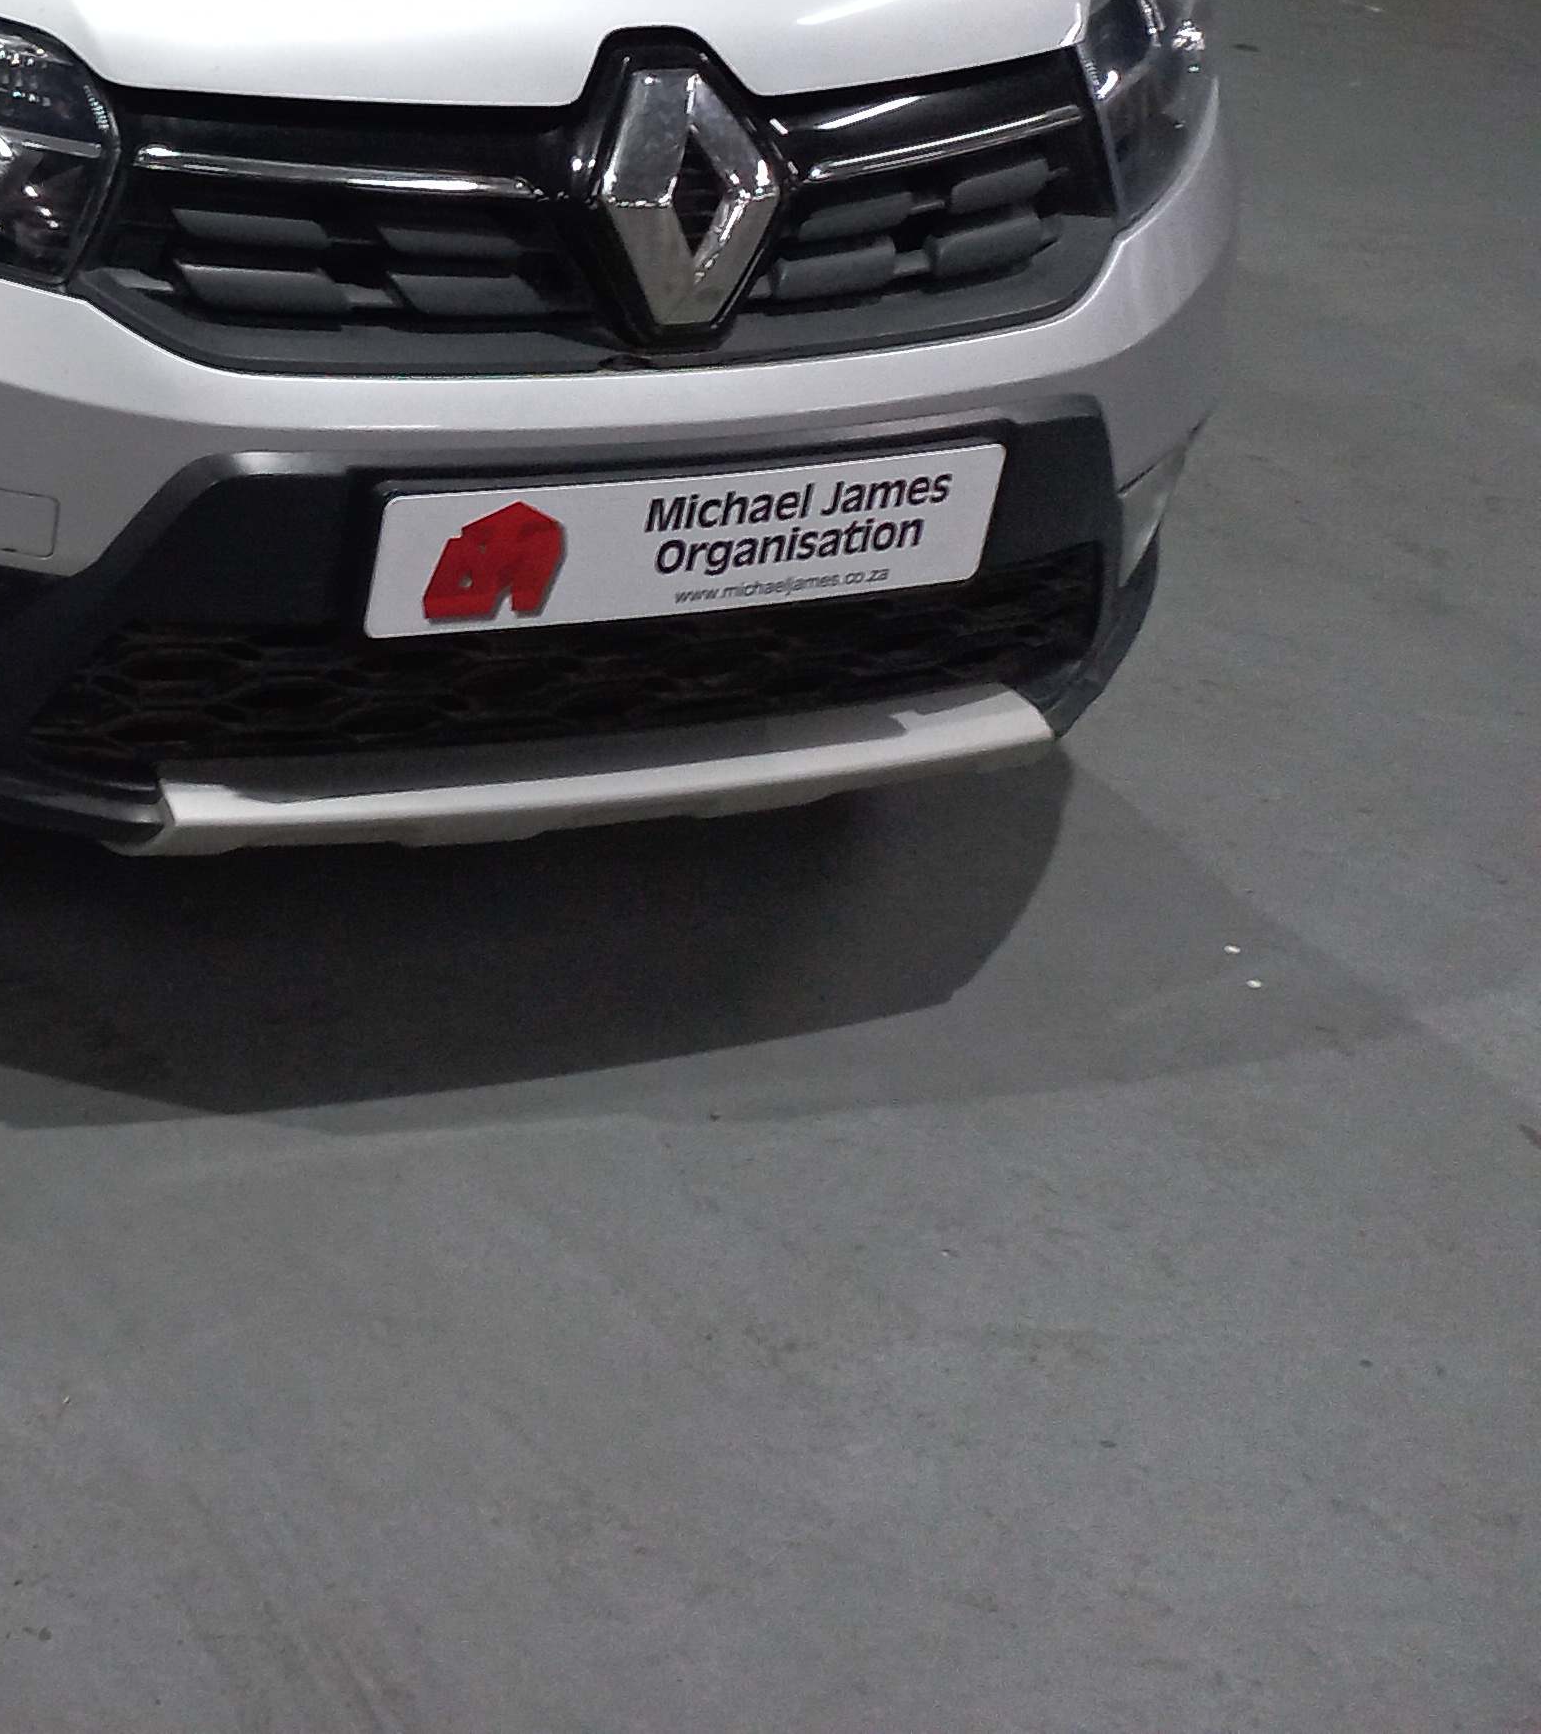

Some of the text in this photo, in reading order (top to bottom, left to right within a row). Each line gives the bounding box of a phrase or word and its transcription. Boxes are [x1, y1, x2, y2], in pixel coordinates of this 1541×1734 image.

[644, 473, 953, 533] Michael James
[654, 517, 925, 576] Organisation
[674, 568, 890, 604] www.michaeljames.co.za
